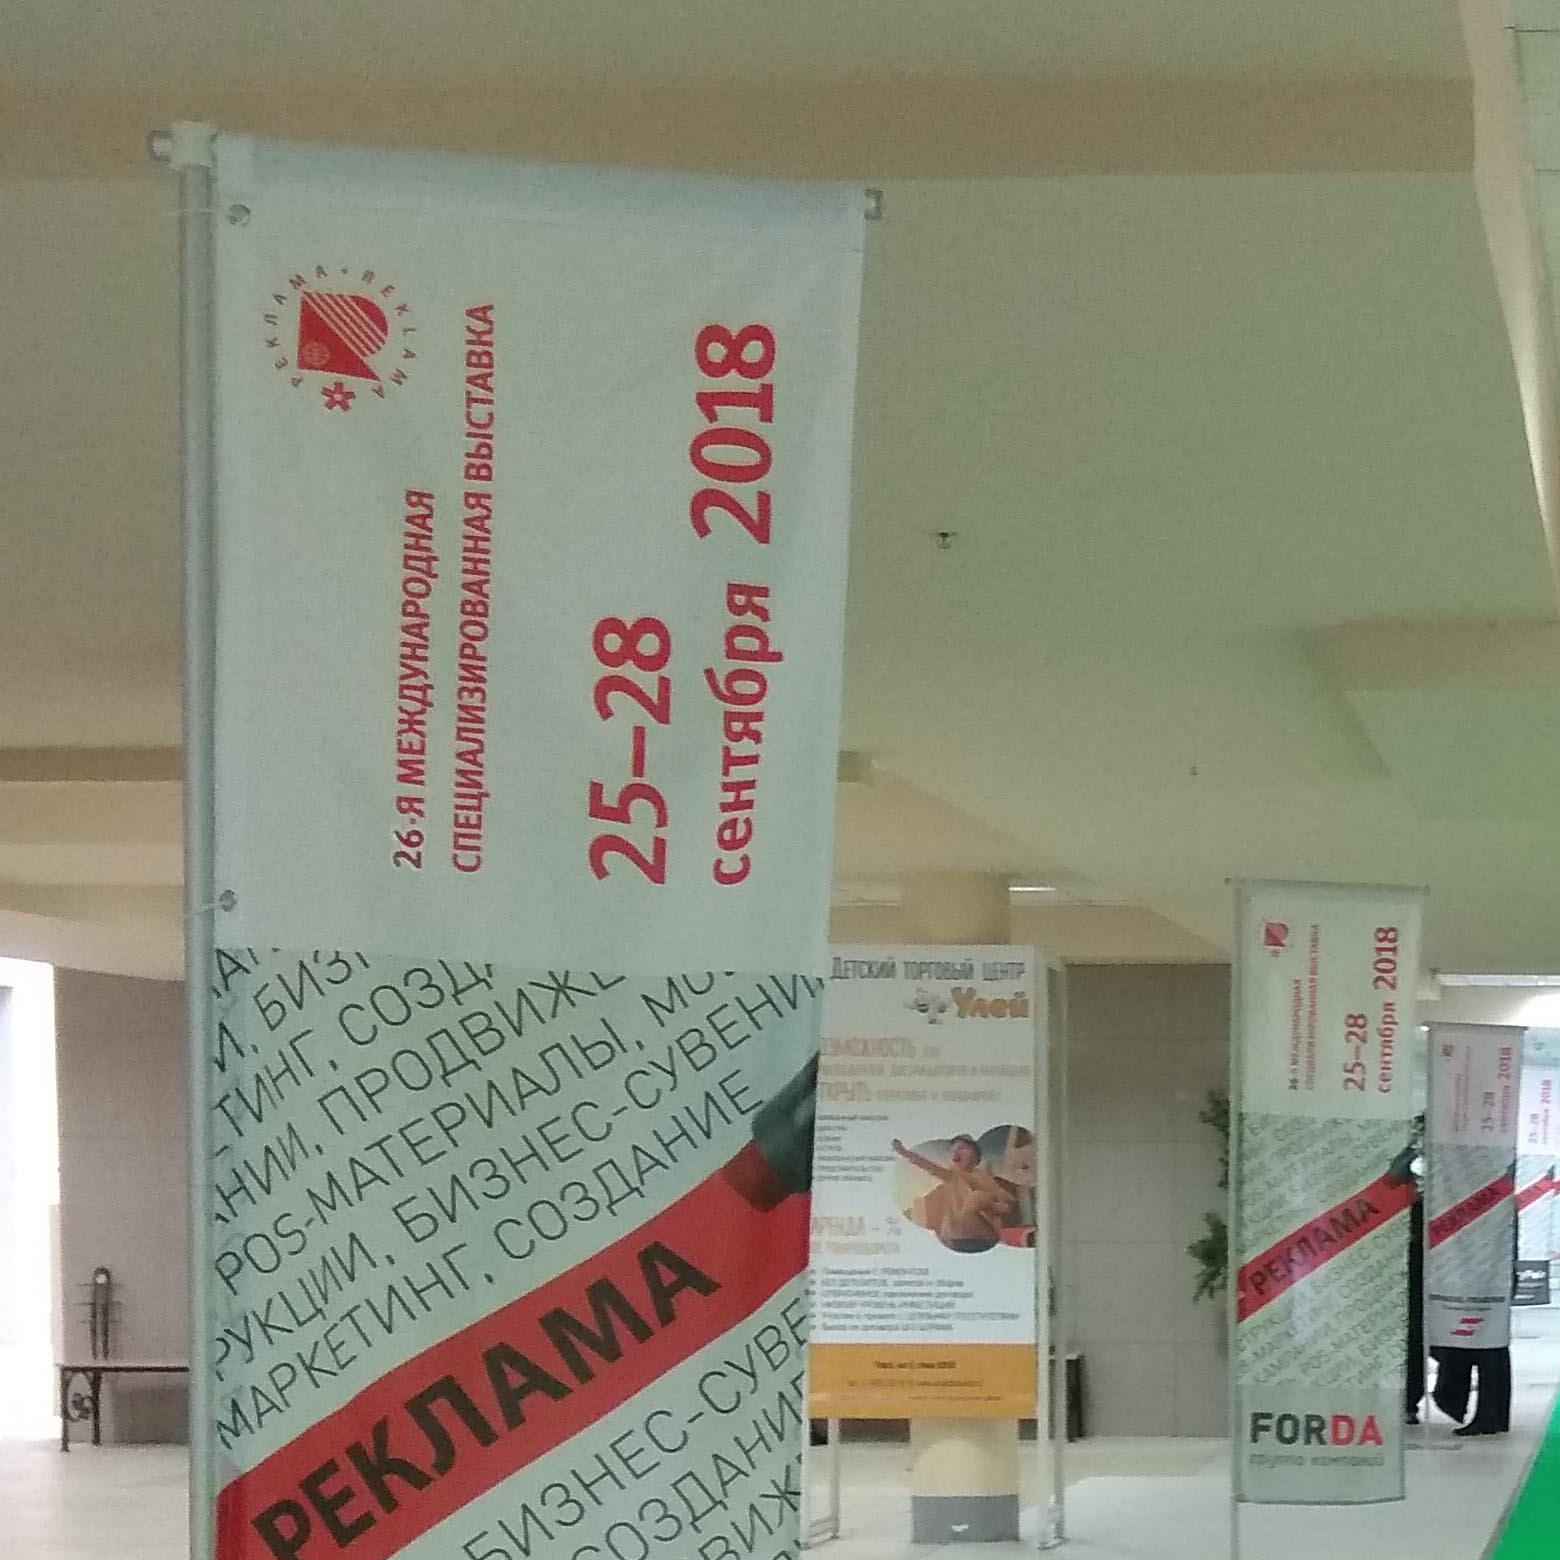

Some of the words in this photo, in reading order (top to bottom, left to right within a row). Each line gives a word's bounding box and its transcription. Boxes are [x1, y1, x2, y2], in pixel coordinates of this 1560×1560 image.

[463, 303, 496, 483] ВЫСТАВКА
[688, 322, 777, 545] 2018
[395, 489, 438, 787] МЕЖДУНАРОДНАЯ
[450, 490, 494, 873] СПЕЦИАЛИЗИРОВАННАЯ
[703, 582, 784, 887] сентября
[1372, 926, 1400, 992] 2018
[1376, 1002, 1399, 1094] сентября
[494, 1067, 763, 1260] СОЗДАНИЕ
[1248, 1198, 1379, 1297] РЕКЛАМА
[1250, 1412, 1384, 1446] FORDA
